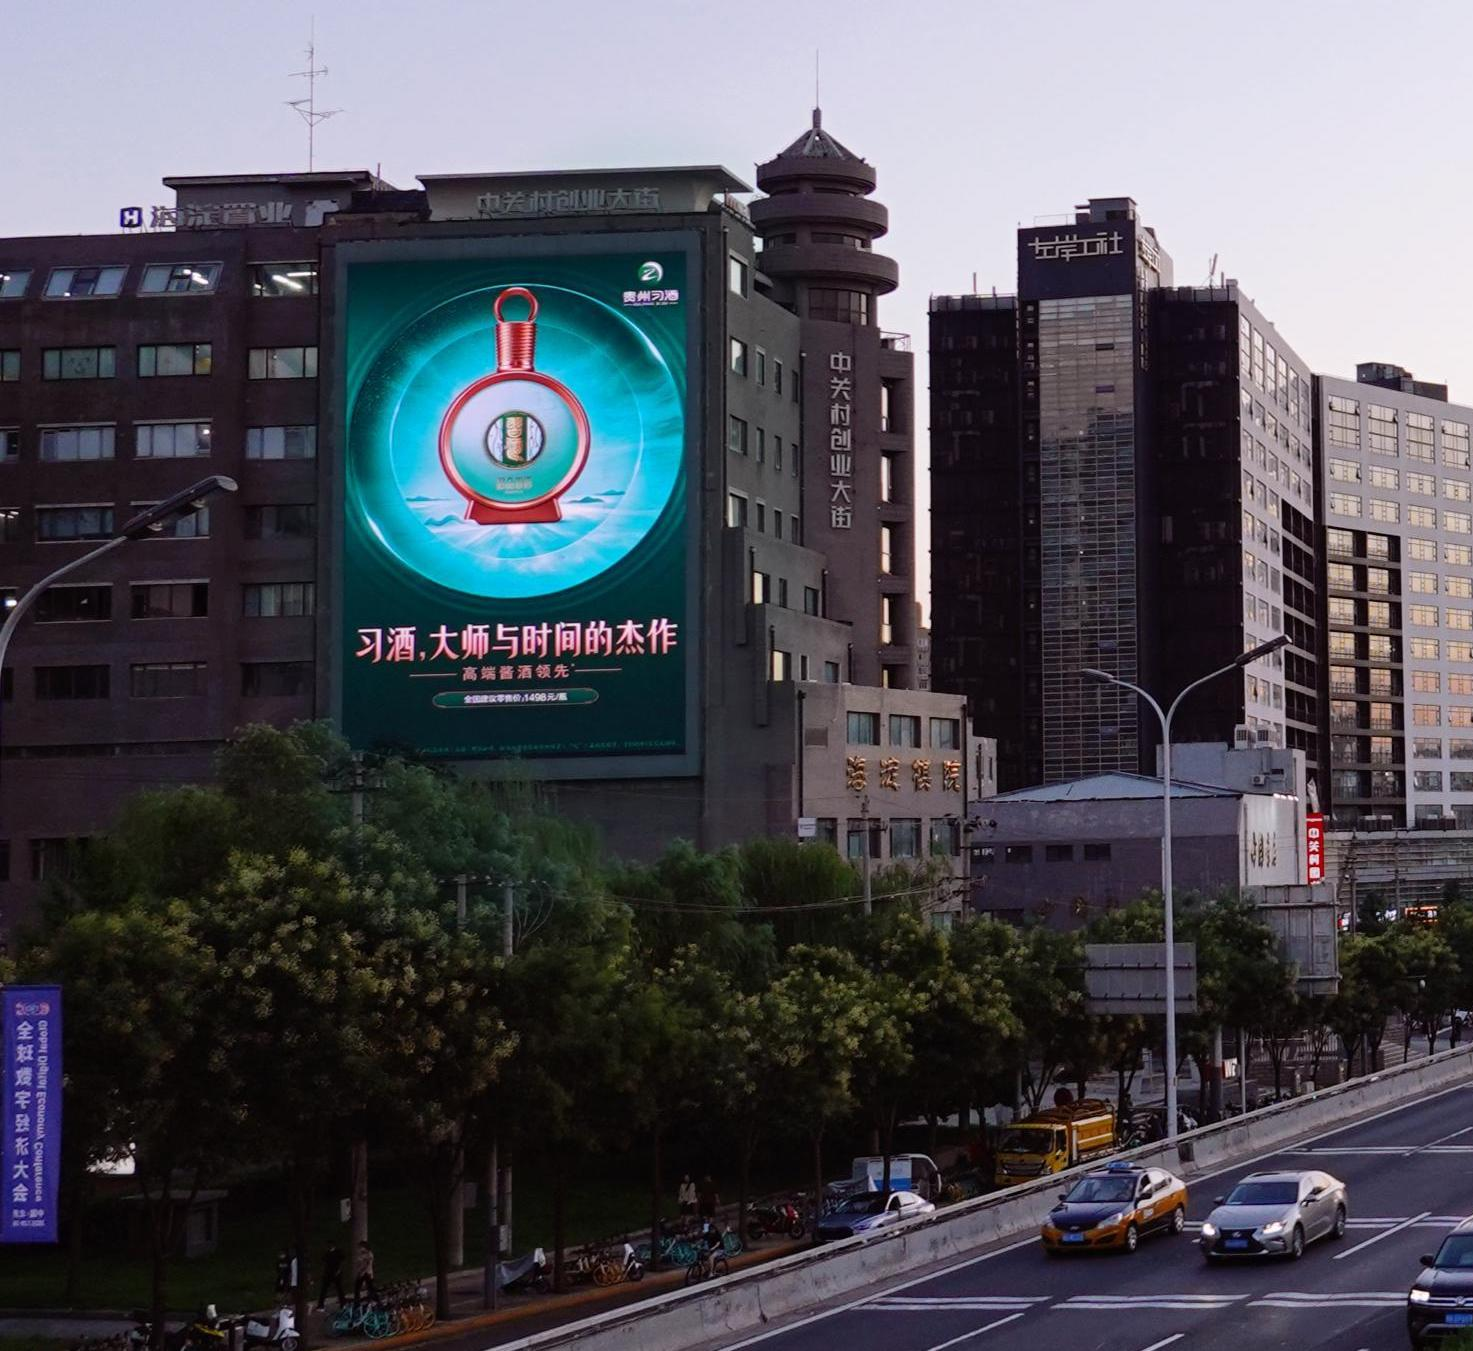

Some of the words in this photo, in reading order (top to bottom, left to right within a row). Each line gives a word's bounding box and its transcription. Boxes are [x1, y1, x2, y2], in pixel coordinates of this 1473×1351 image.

[477, 187, 660, 214] 中关村创业大街
[830, 351, 852, 529] 中关村创业大街
[355, 617, 679, 664] 习酒,大师与时间的杰作
